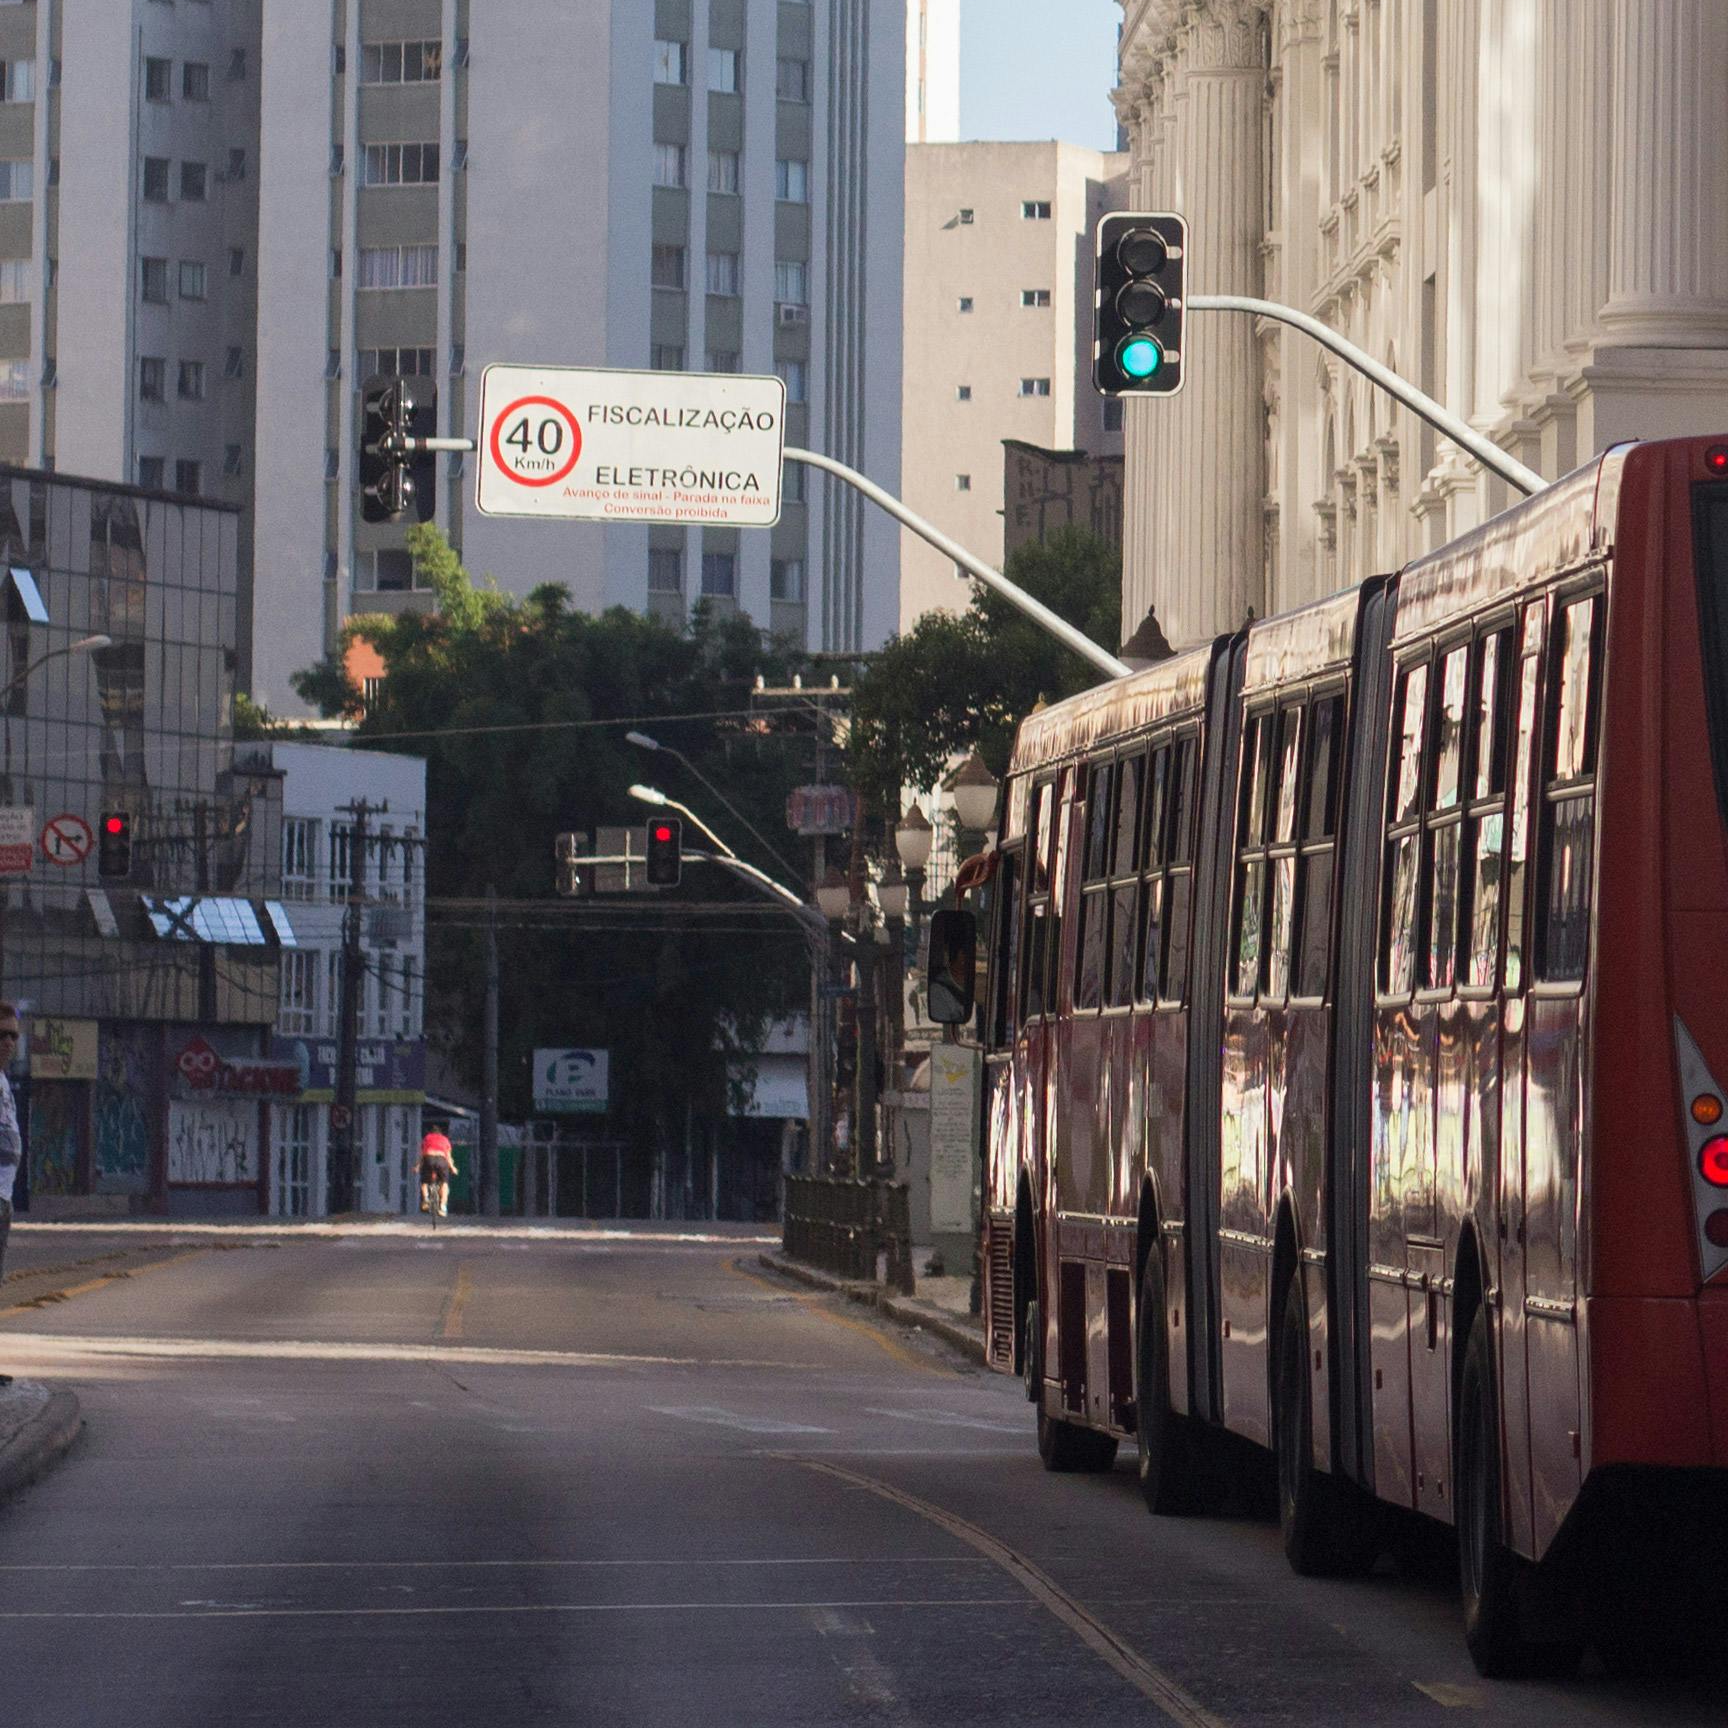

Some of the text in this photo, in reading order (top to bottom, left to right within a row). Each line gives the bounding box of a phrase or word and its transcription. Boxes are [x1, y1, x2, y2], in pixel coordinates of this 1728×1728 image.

[587, 404, 775, 434] FISCALIZAÇÃO
[505, 417, 564, 455] 40
[514, 456, 556, 472] Km/h
[596, 465, 760, 491] ELETRÔNICA
[562, 486, 609, 500] Avanço
[613, 489, 630, 499] de
[632, 490, 663, 501] sinal
[673, 491, 718, 504] Parada
[721, 495, 737, 505] na
[740, 493, 770, 505] faixa
[604, 503, 728, 519] Conversão proibida
